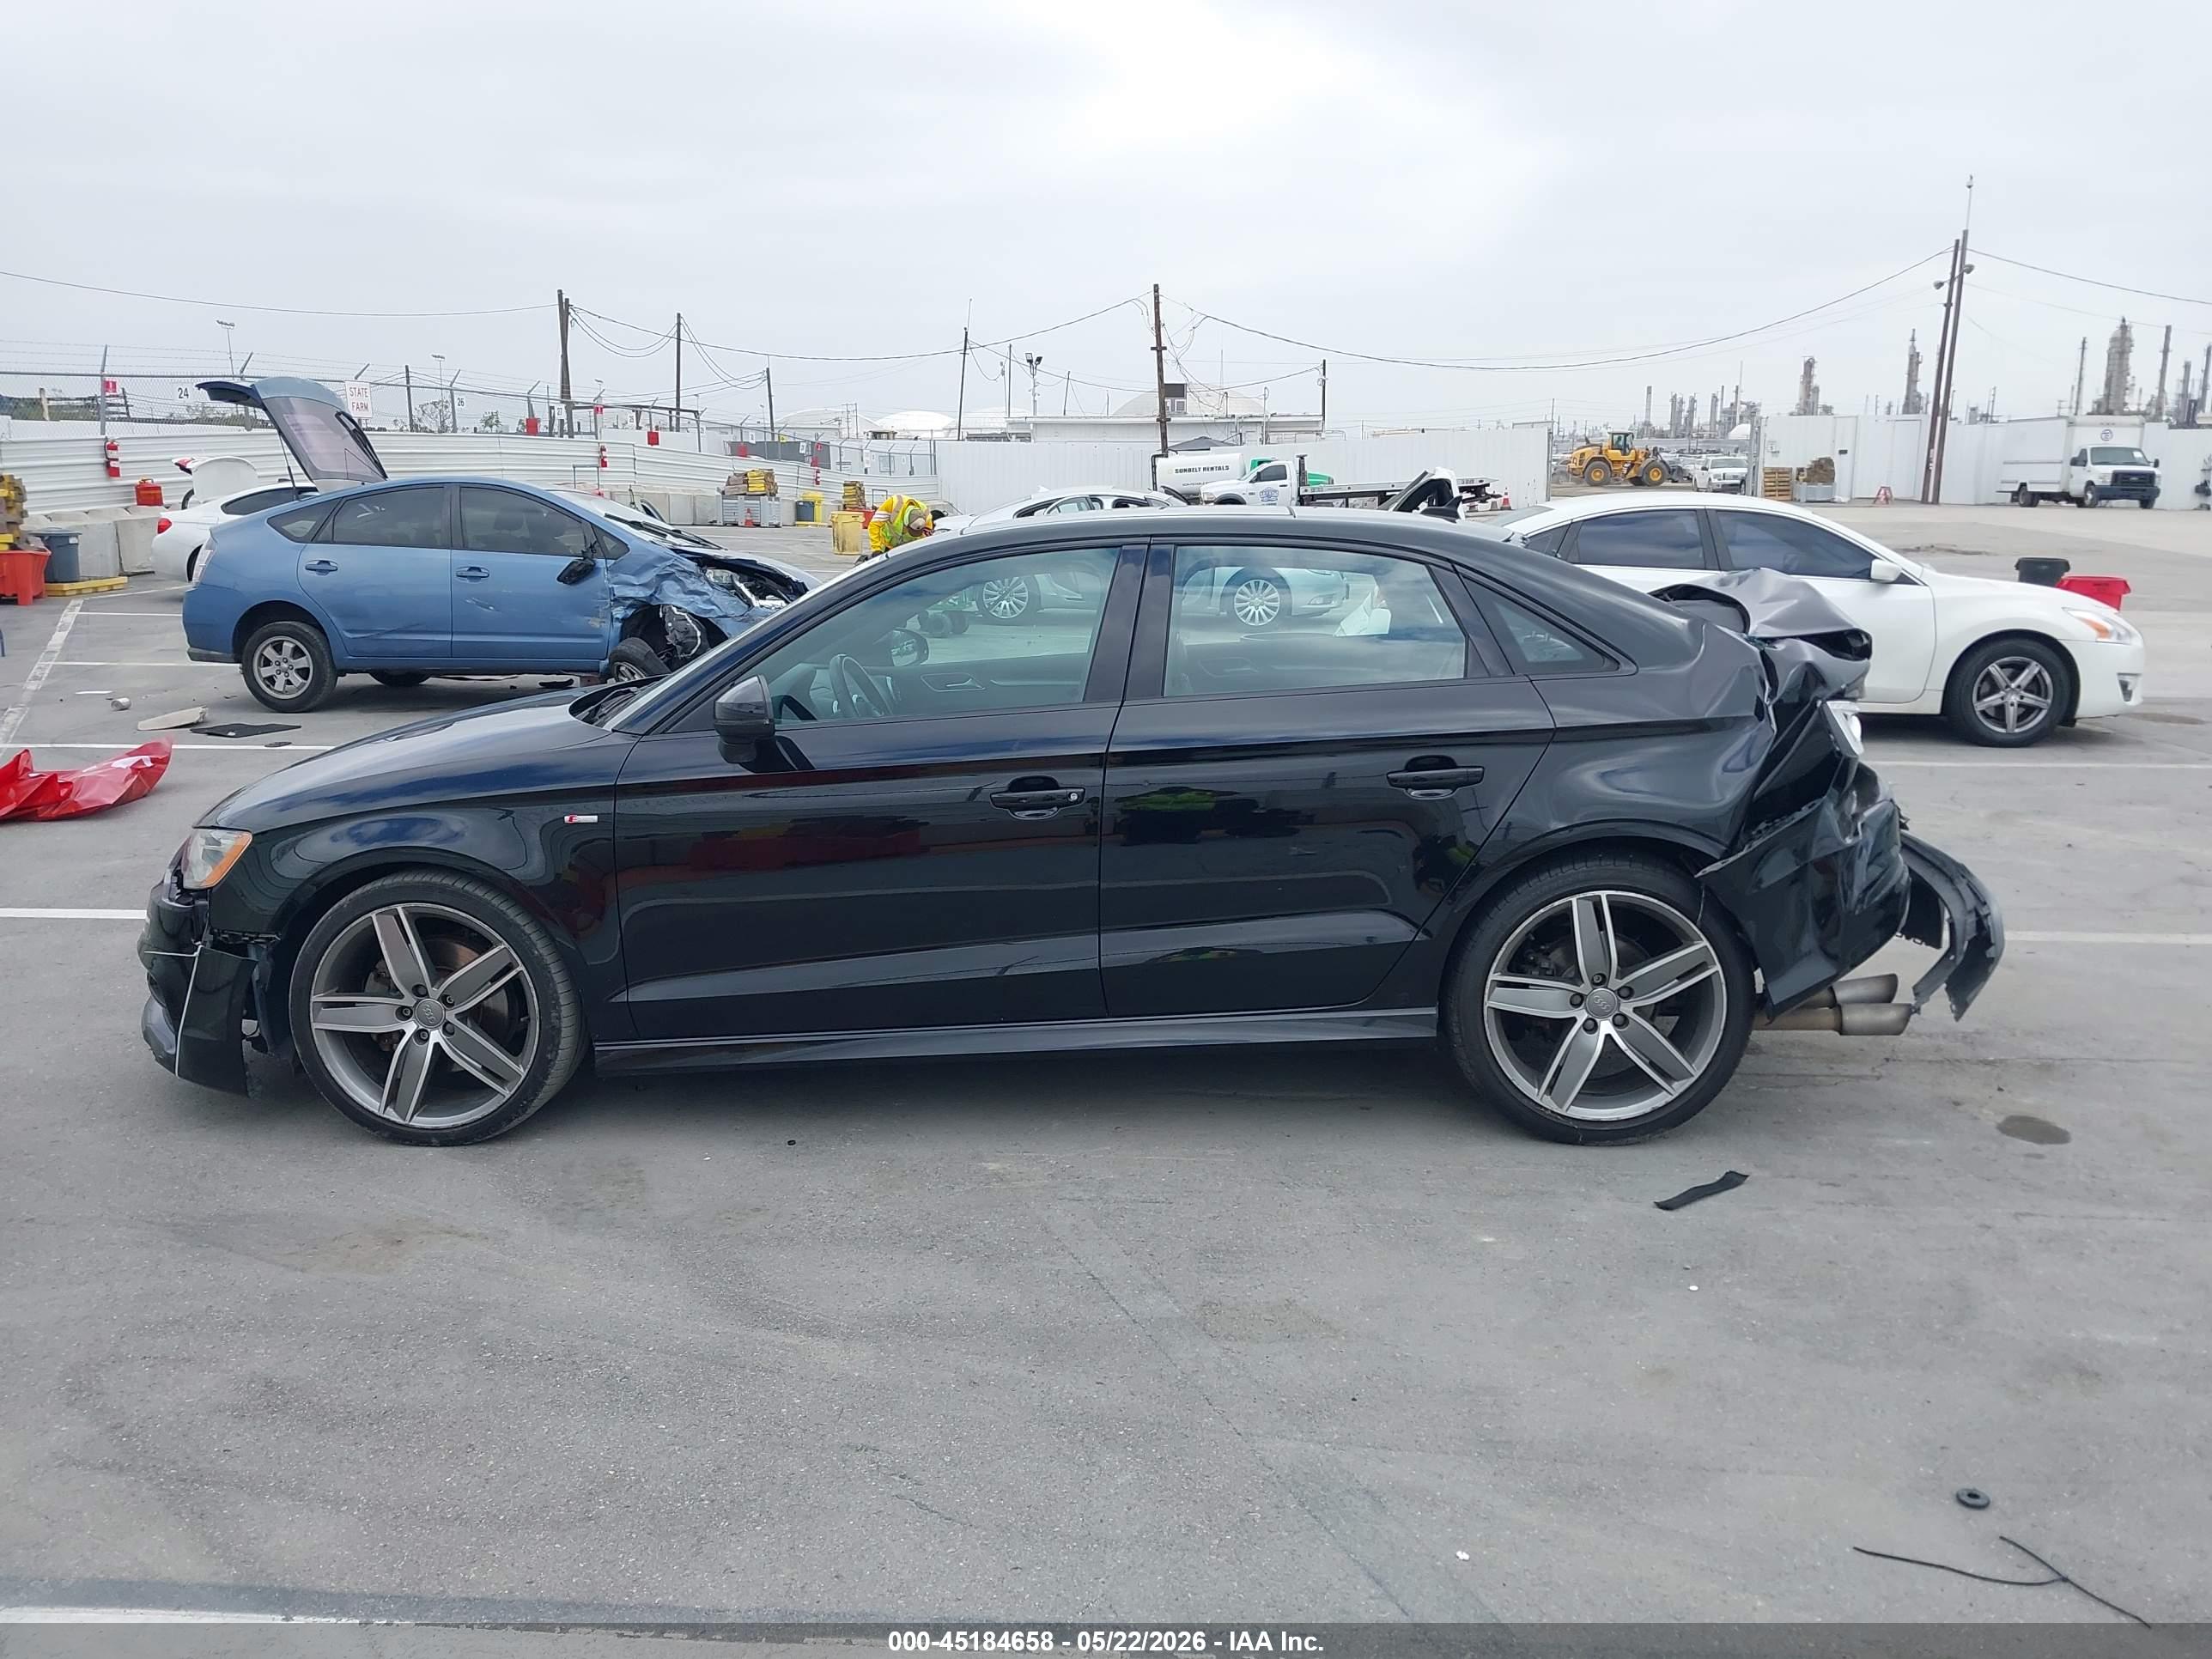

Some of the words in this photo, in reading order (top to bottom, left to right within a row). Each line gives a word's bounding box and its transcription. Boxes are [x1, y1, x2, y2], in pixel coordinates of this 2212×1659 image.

[177, 387, 189, 398] 24
[349, 387, 368, 398] STATE
[351, 402, 369, 411] FARM
